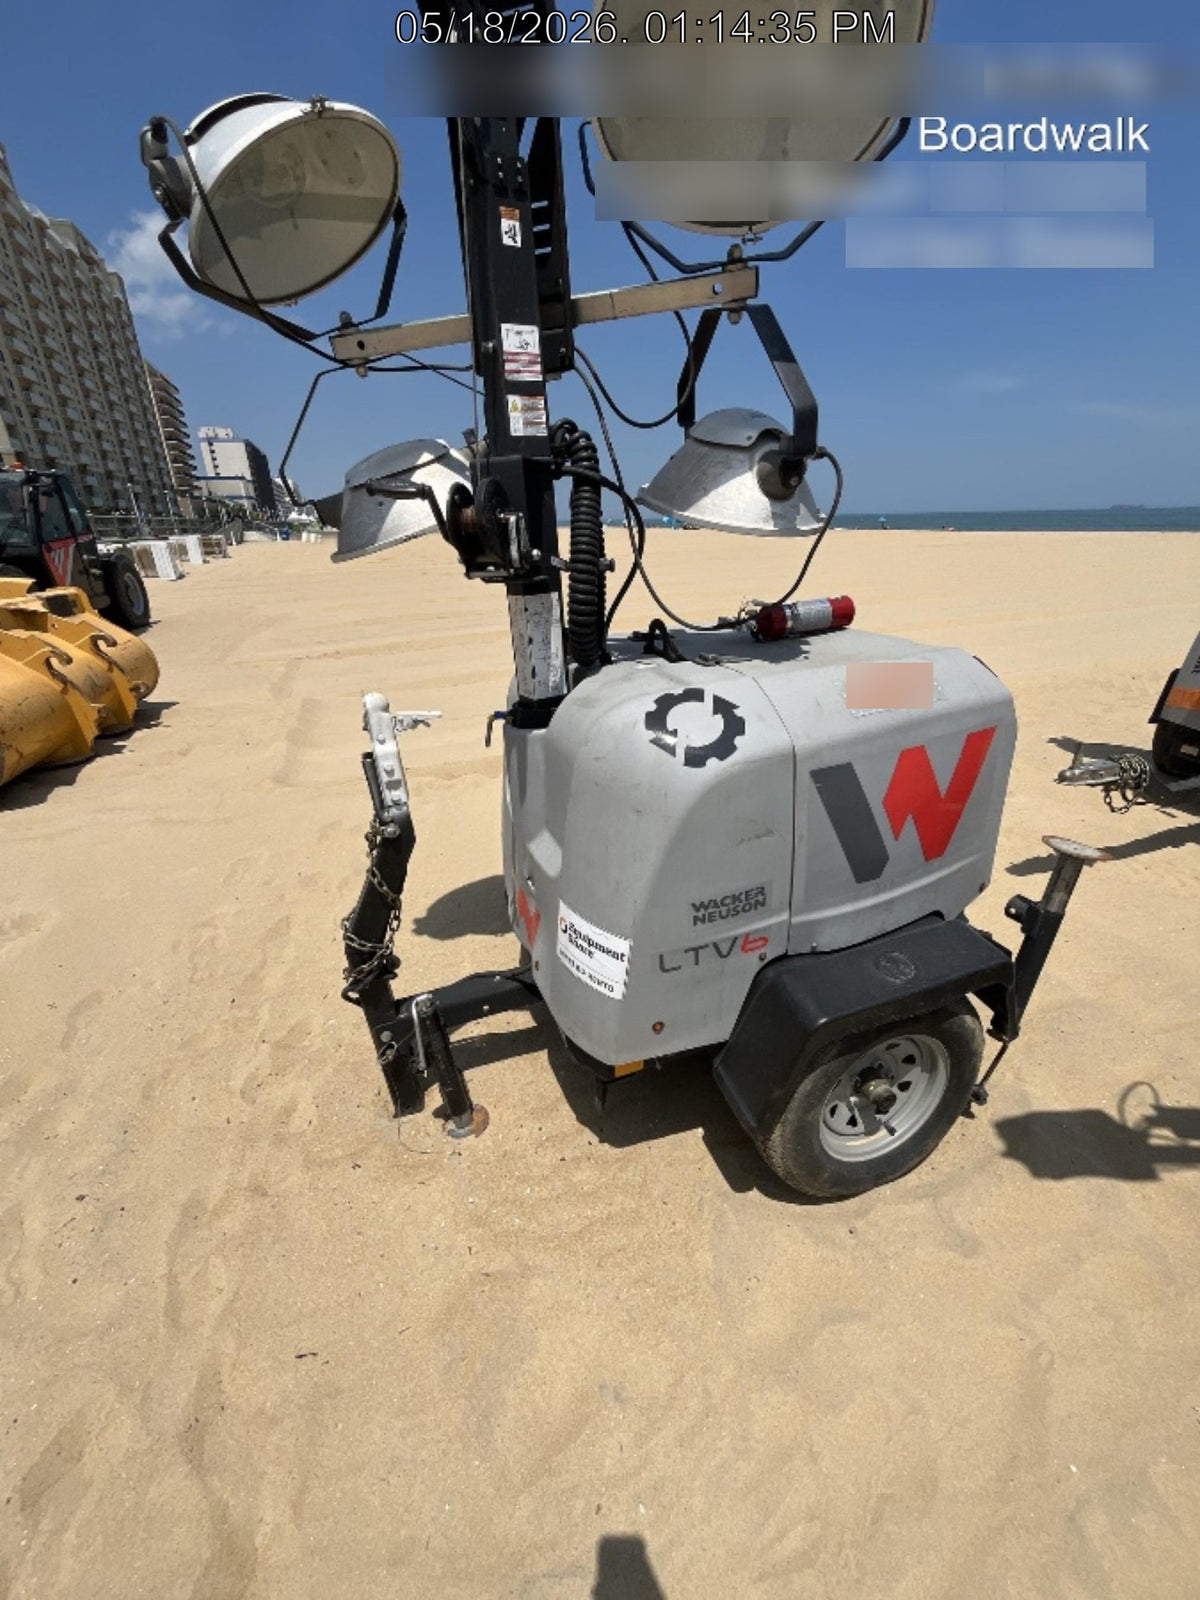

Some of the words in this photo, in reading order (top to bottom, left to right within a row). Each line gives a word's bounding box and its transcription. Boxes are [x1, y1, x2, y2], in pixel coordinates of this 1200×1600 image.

[691, 886, 766, 912] WACKER
[693, 898, 766, 926] NEUSON
[659, 932, 769, 973] LTV6
